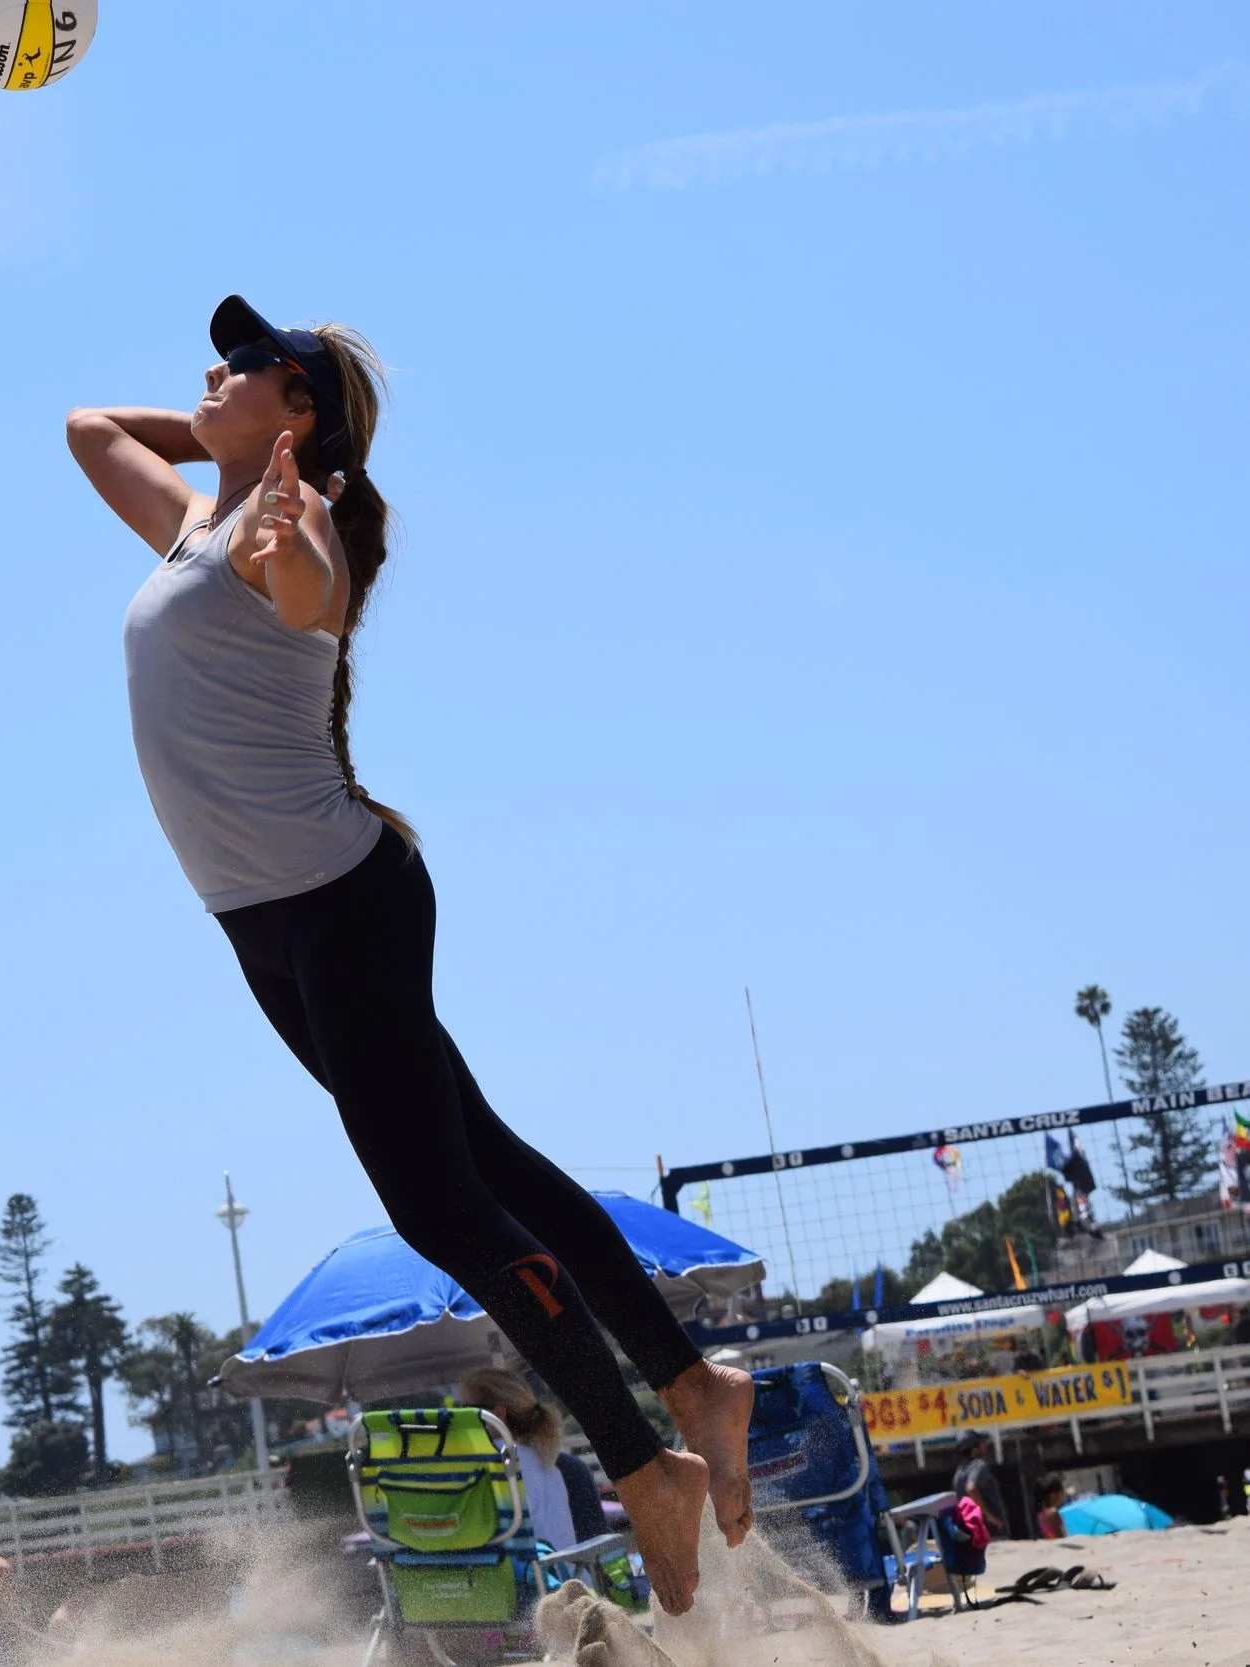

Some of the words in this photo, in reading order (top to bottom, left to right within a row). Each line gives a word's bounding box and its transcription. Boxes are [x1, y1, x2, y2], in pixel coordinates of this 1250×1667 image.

[19, 71, 38, 89] avp
[944, 1118, 1015, 1143] SANTA
[1019, 1110, 1081, 1132] CRUZ
[1131, 1091, 1196, 1115] MAIN
[937, 1282, 1108, 1316] www.santacruzwharf.com
[957, 1388, 1008, 1422] SODA
[1031, 1371, 1098, 1409] WATER
